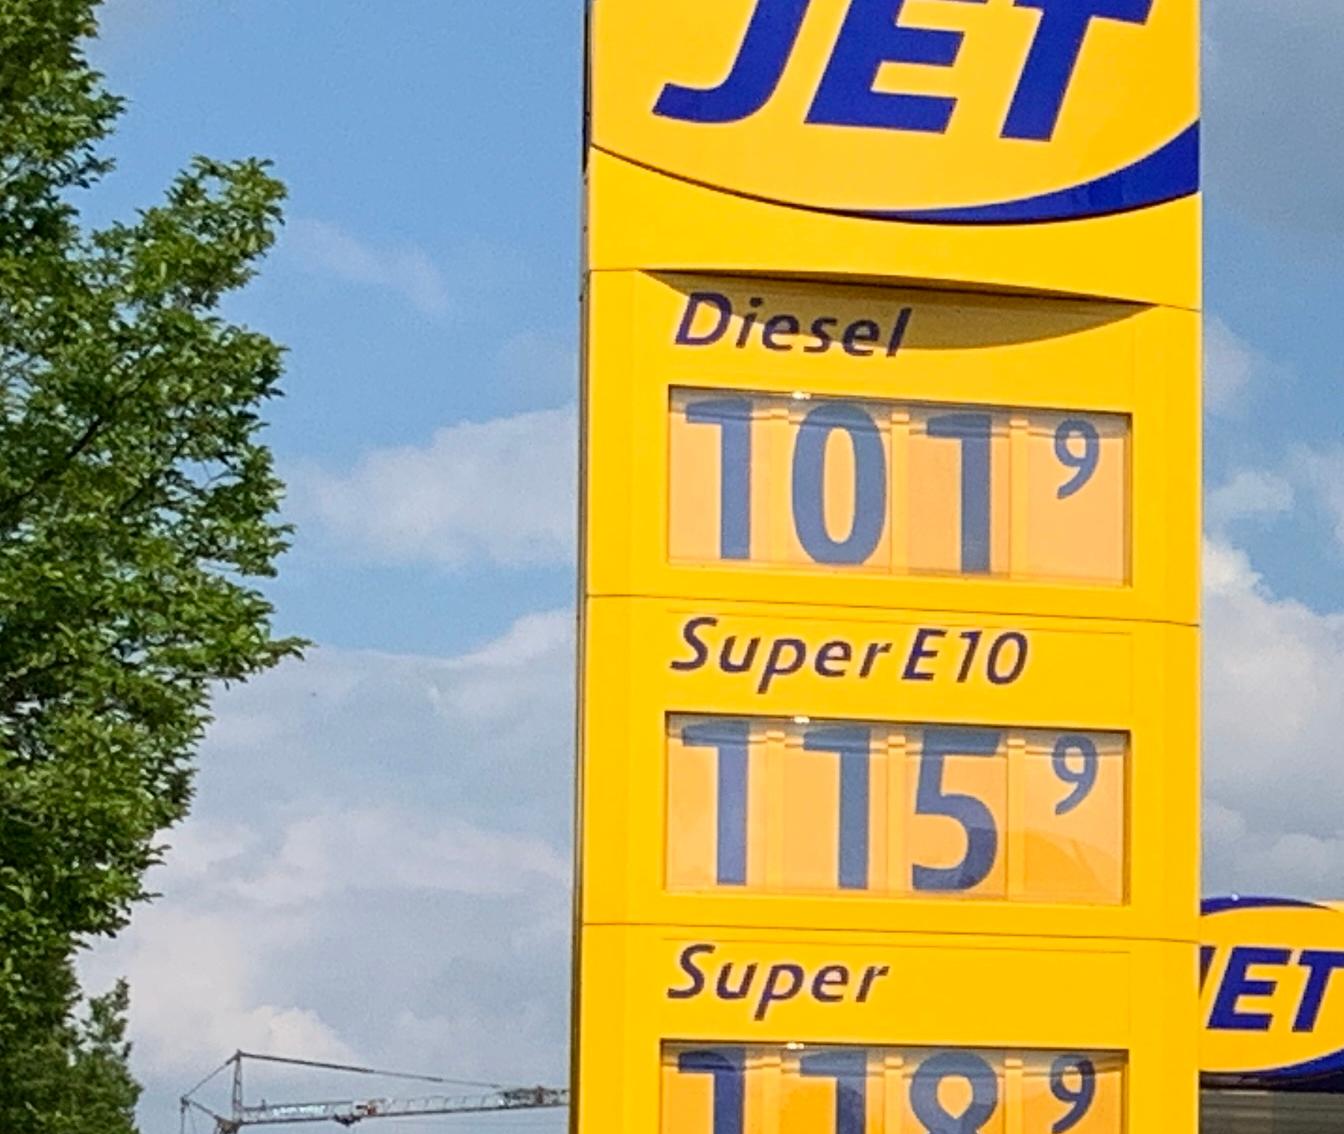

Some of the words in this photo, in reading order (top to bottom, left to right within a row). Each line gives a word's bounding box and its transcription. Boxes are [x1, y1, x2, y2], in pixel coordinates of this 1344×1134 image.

[652, 0, 1153, 142] JET
[674, 292, 912, 358] Diesel
[670, 617, 892, 694] Super
[901, 629, 1029, 685] E10
[667, 944, 890, 1021] Super
